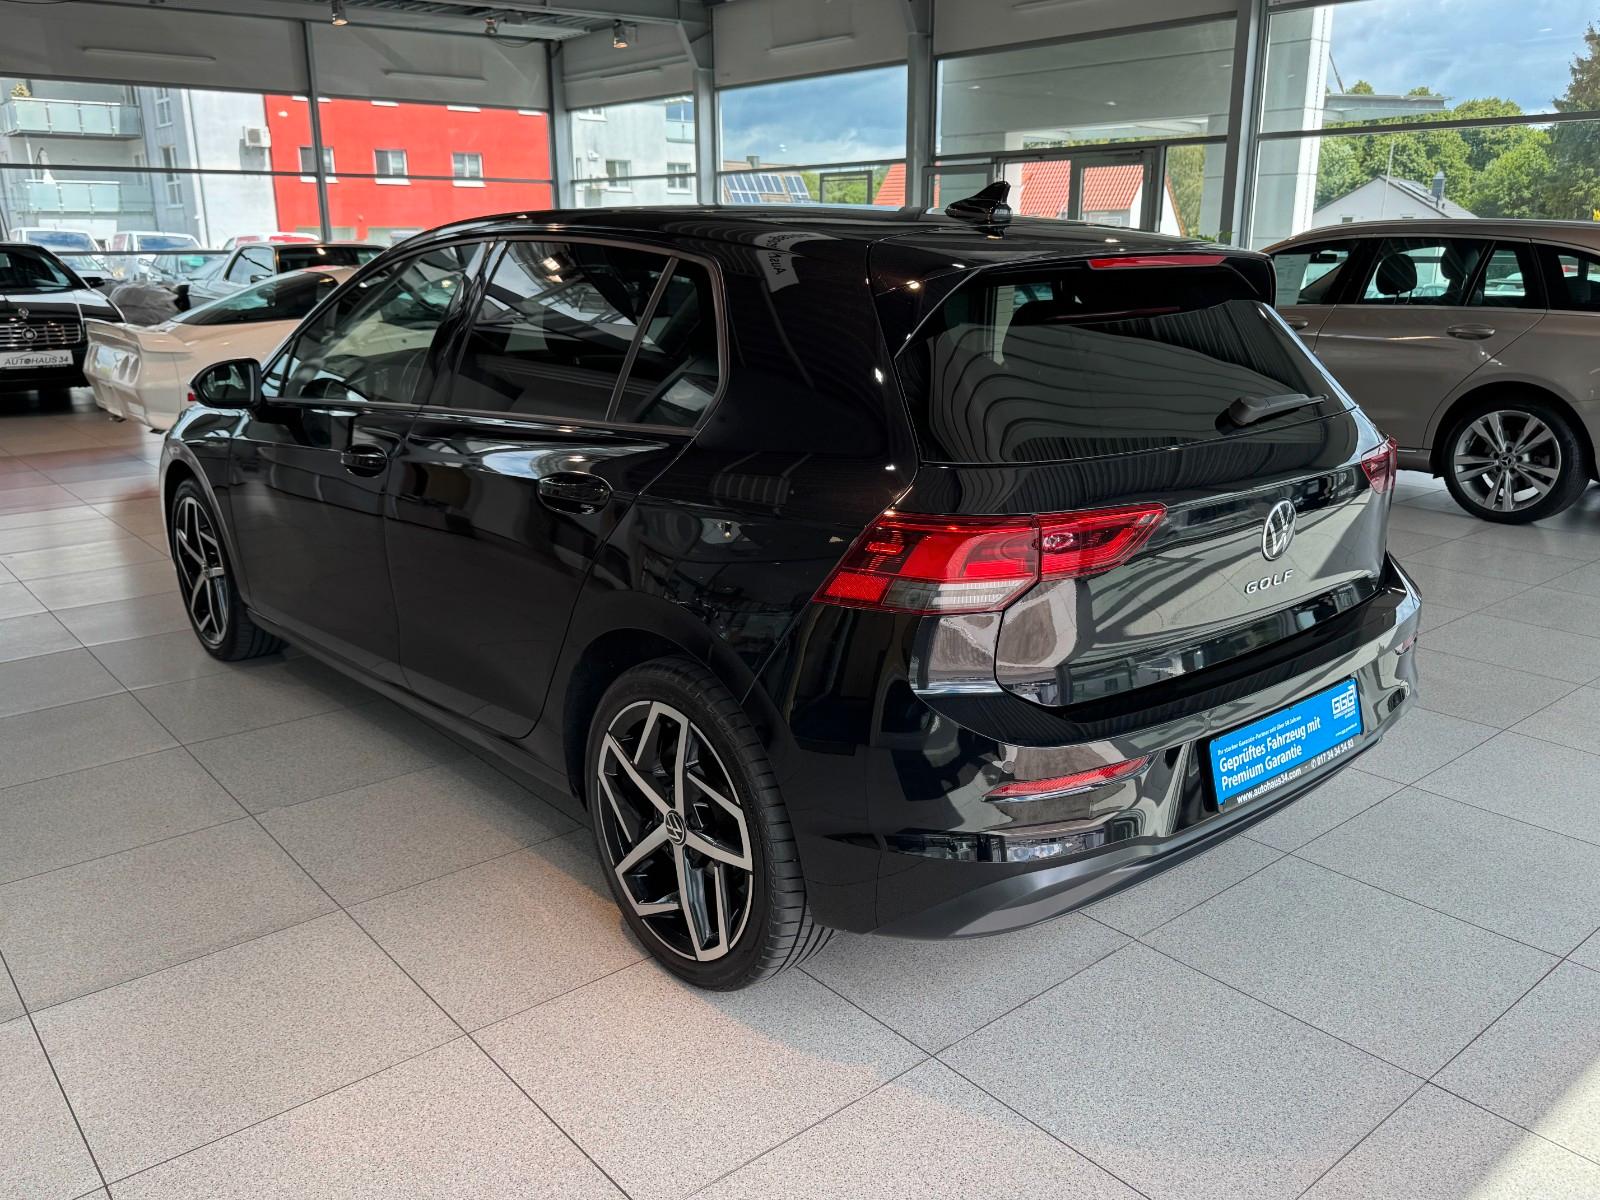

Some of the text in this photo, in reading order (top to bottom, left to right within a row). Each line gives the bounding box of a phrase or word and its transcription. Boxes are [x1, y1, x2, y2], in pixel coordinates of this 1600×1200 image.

[4, 356, 58, 366] AUTOHAUS
[1244, 568, 1294, 594] GOLF
[1219, 743, 1266, 773] Geprüftes
[1266, 726, 1306, 752] Fahrzeug
[1307, 716, 1321, 735] mit
[1221, 744, 1303, 791] Premium Garantie
[1236, 768, 1302, 804] www.autohaus34.com
